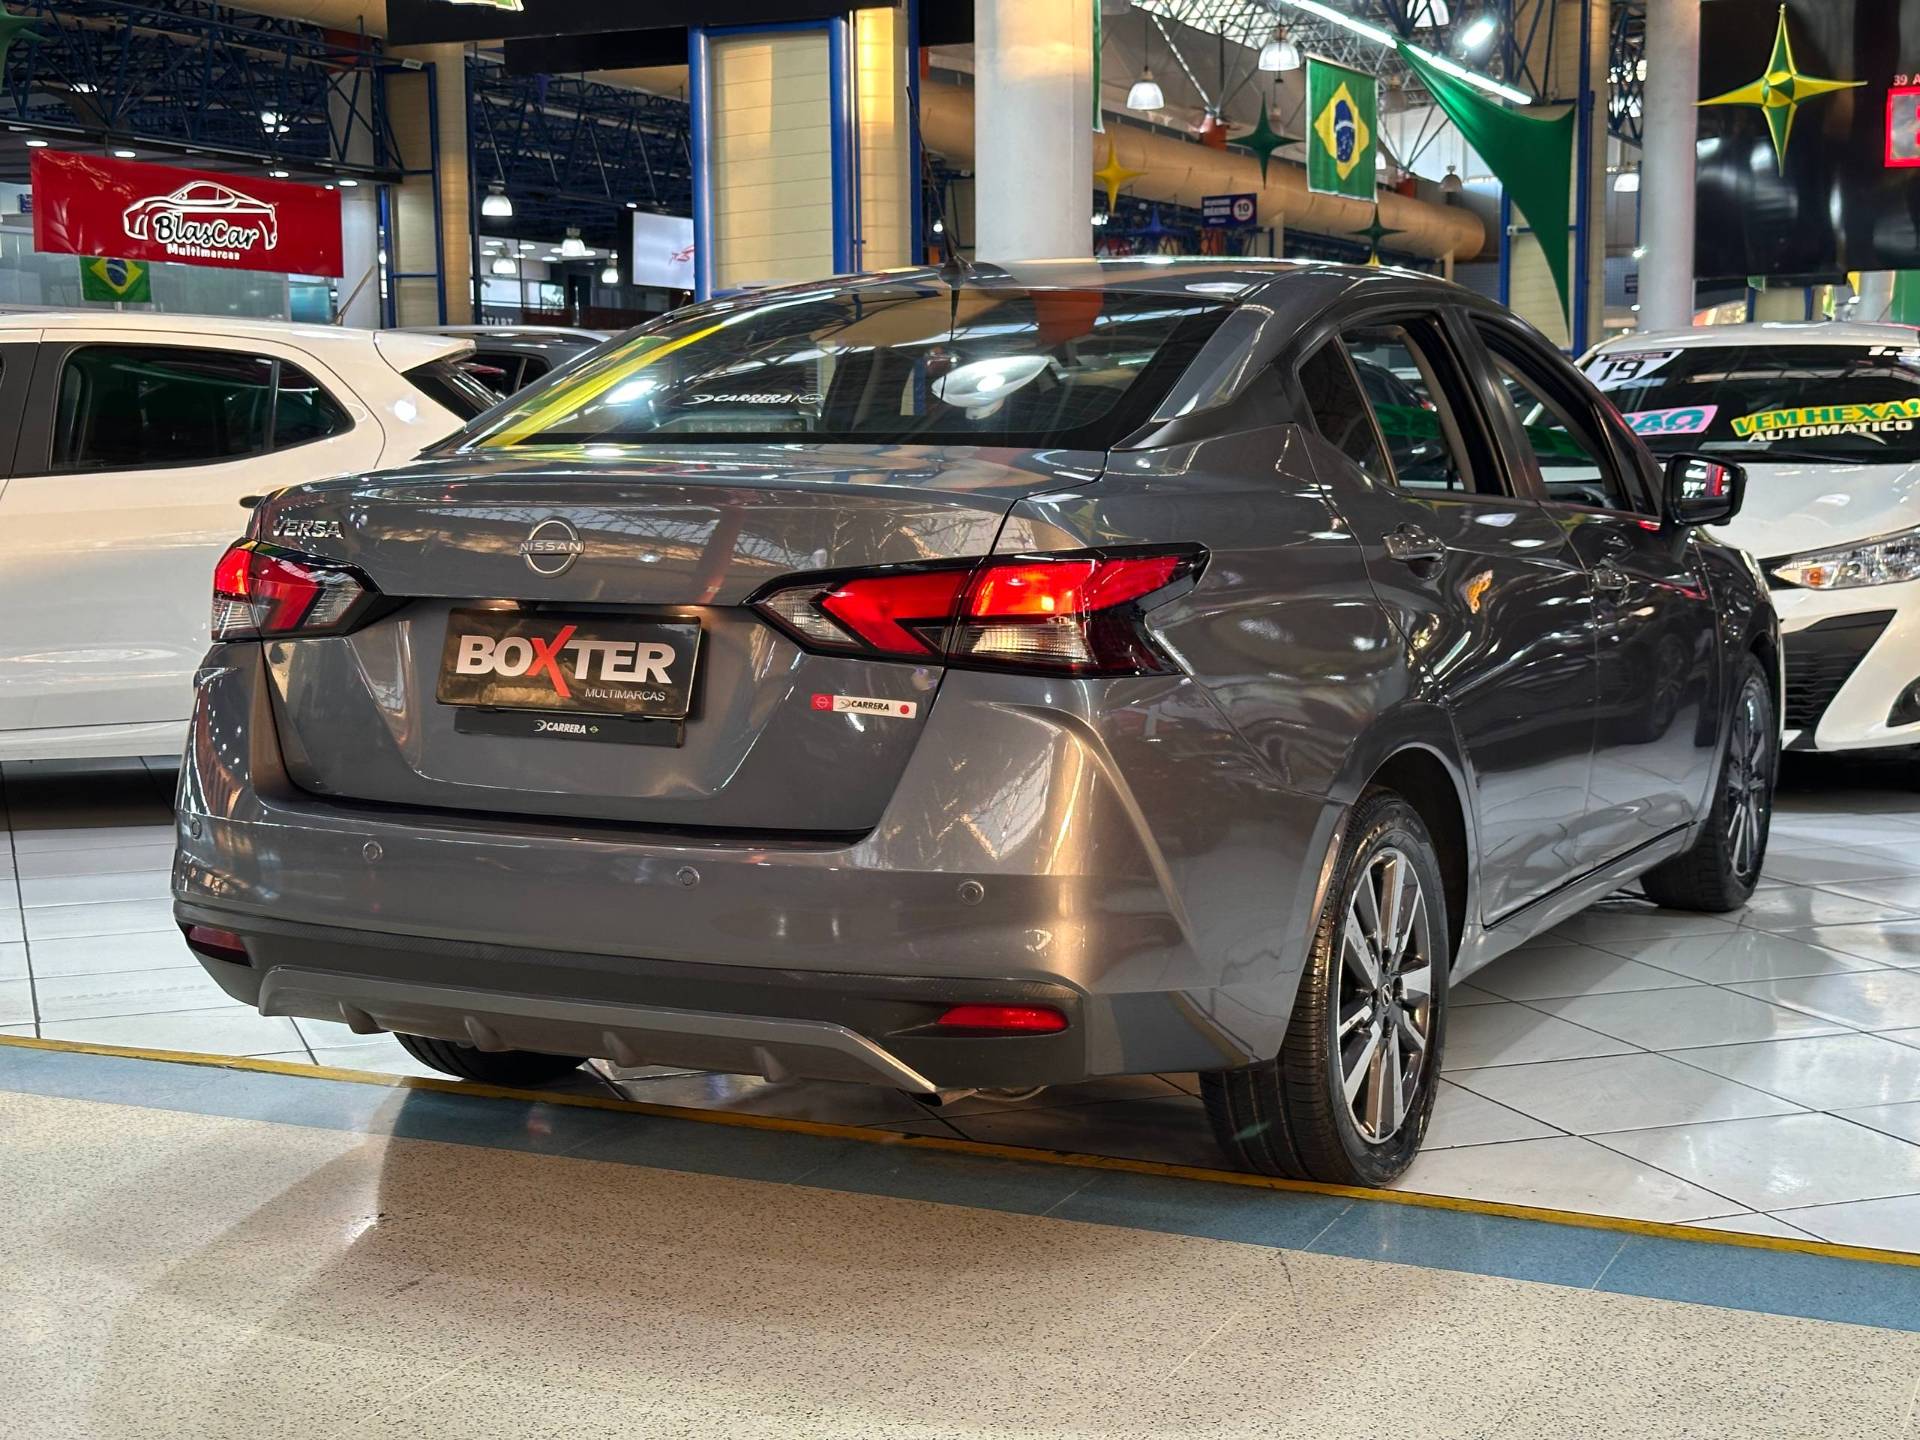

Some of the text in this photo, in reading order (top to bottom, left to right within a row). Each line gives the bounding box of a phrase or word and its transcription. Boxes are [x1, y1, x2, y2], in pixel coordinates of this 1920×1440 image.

[1237, 202, 1250, 213] 10
[154, 211, 259, 250] BlasCar
[166, 244, 240, 261] Multimarcas
[1597, 360, 1646, 383] 19
[713, 393, 793, 404] CARRERA
[1732, 408, 1799, 436] VEM
[1748, 420, 1913, 443] AUTOMATICO
[272, 519, 344, 539] VERSA
[520, 542, 581, 552] NISSAN
[455, 624, 677, 699] BOXTER
[584, 687, 666, 702] MULTIMARCAS
[850, 700, 890, 711] CARRERA
[545, 721, 587, 735] CARRERA
